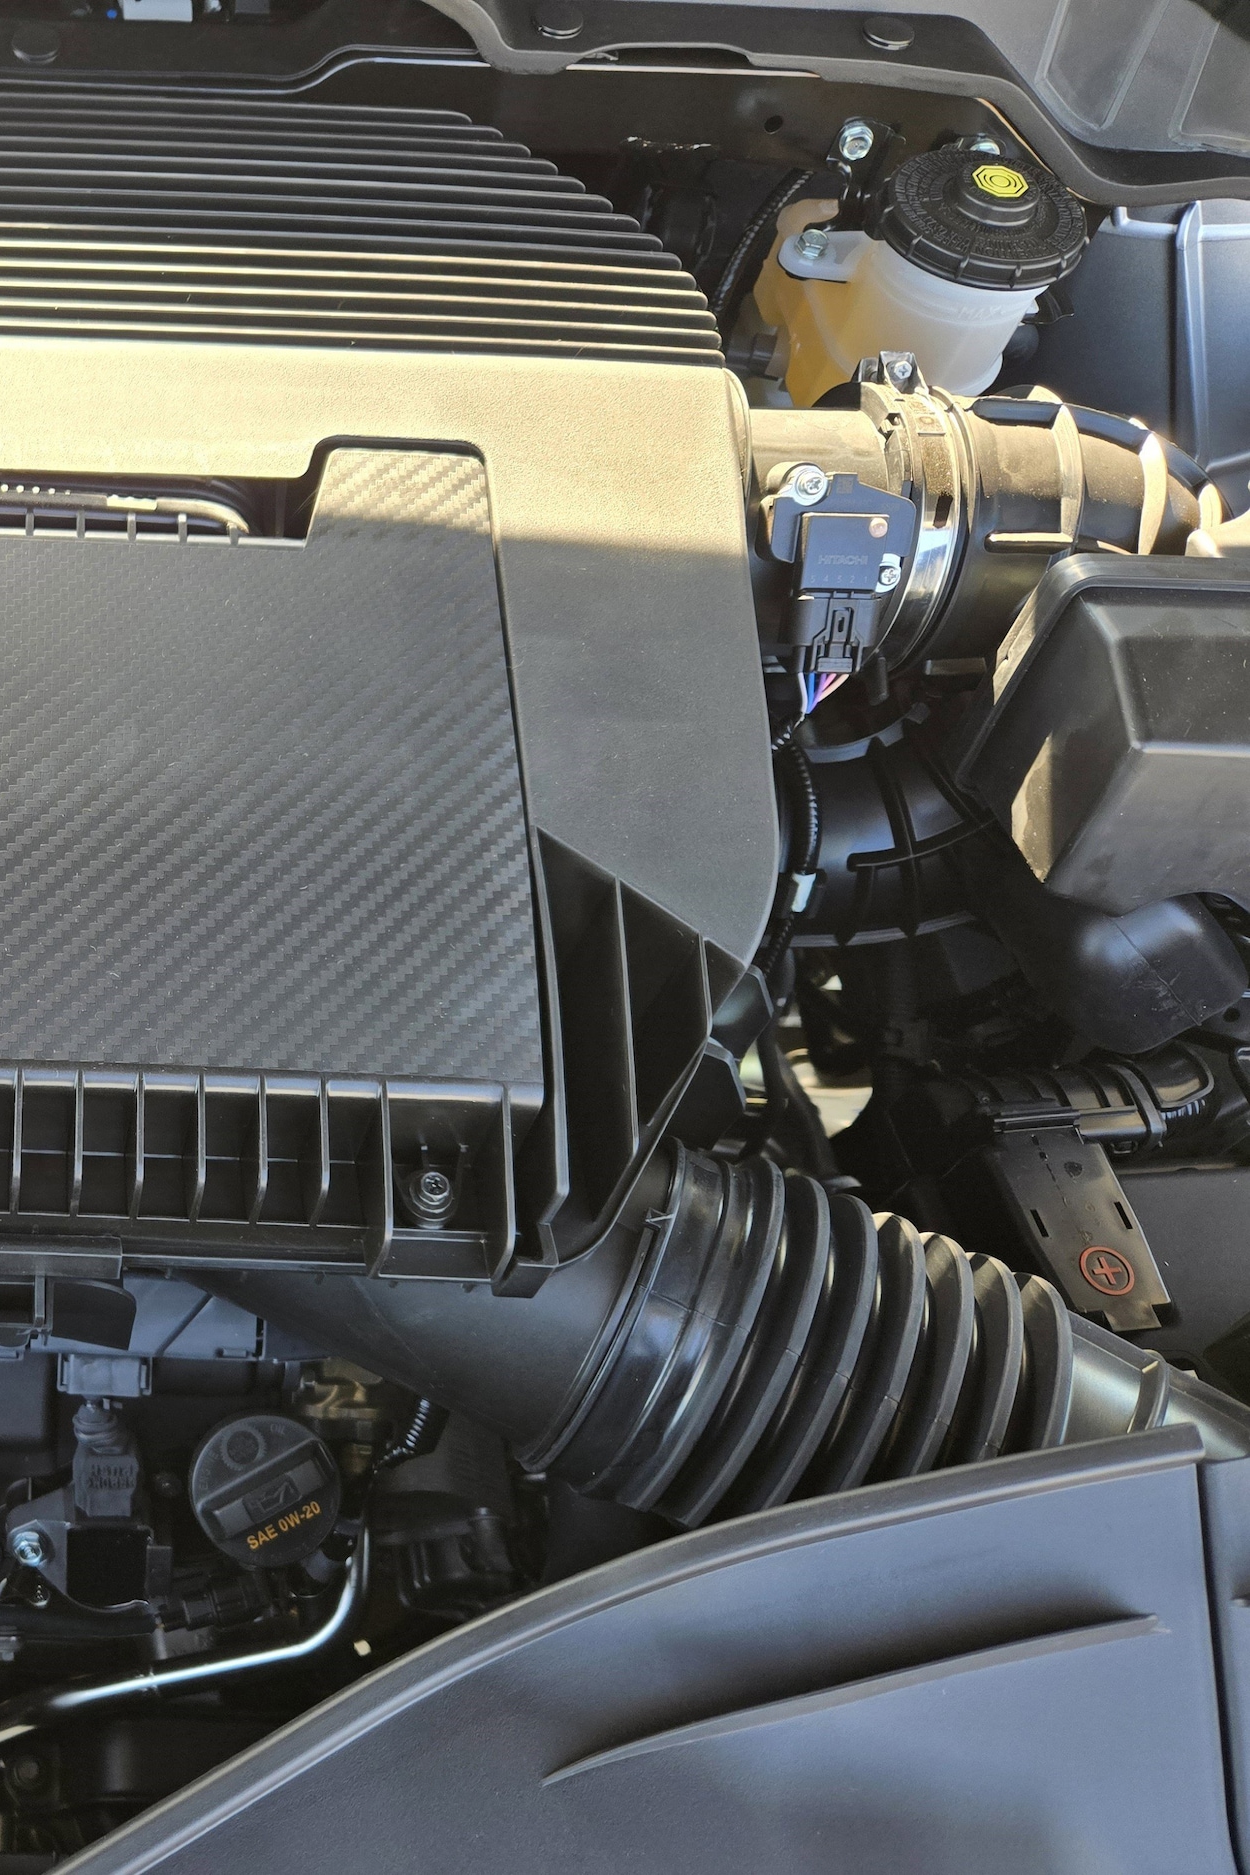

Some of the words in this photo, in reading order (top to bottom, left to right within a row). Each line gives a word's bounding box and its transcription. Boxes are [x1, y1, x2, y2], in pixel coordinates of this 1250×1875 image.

[817, 555, 868, 566] HITACHI
[823, 575, 829, 584] 4
[850, 575, 856, 584] 2
[863, 575, 868, 584] 1
[246, 1523, 279, 1550] SAE
[278, 1500, 322, 1533] 0W-20
